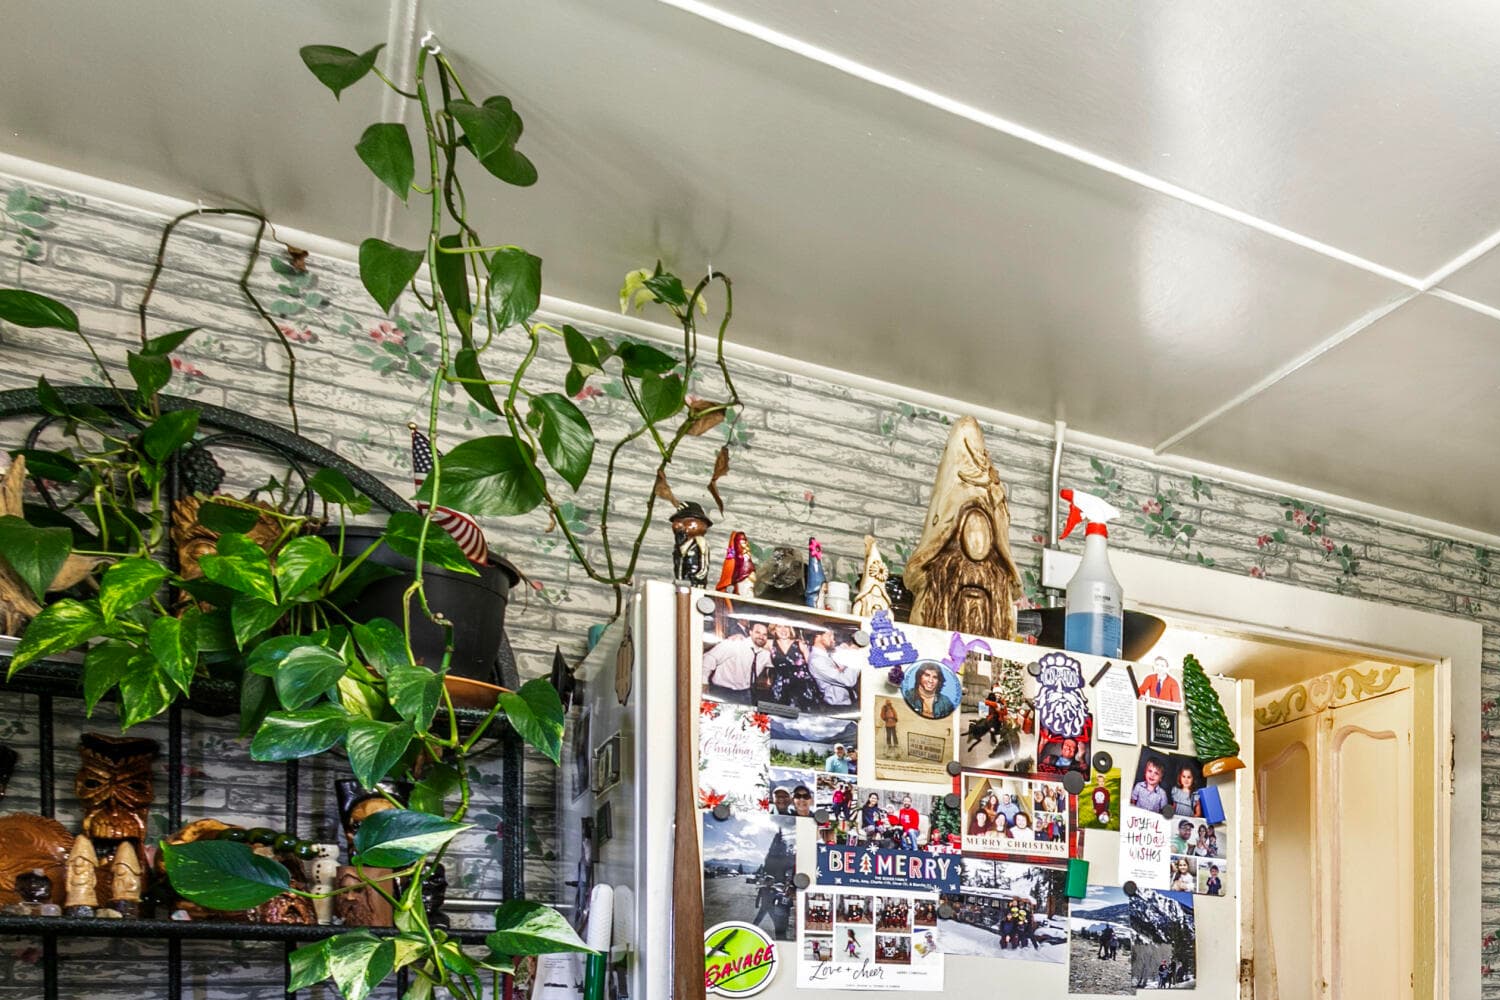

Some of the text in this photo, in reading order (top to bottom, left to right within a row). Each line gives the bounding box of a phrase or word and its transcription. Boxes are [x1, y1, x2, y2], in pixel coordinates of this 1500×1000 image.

[966, 837, 1001, 847] MERRY
[1007, 840, 1065, 852] CHRISTMAS
[829, 850, 950, 880] BE MERRY
[704, 944, 775, 988] SAVAGE
[809, 960, 842, 981] Love
[852, 957, 885, 980] cheer
